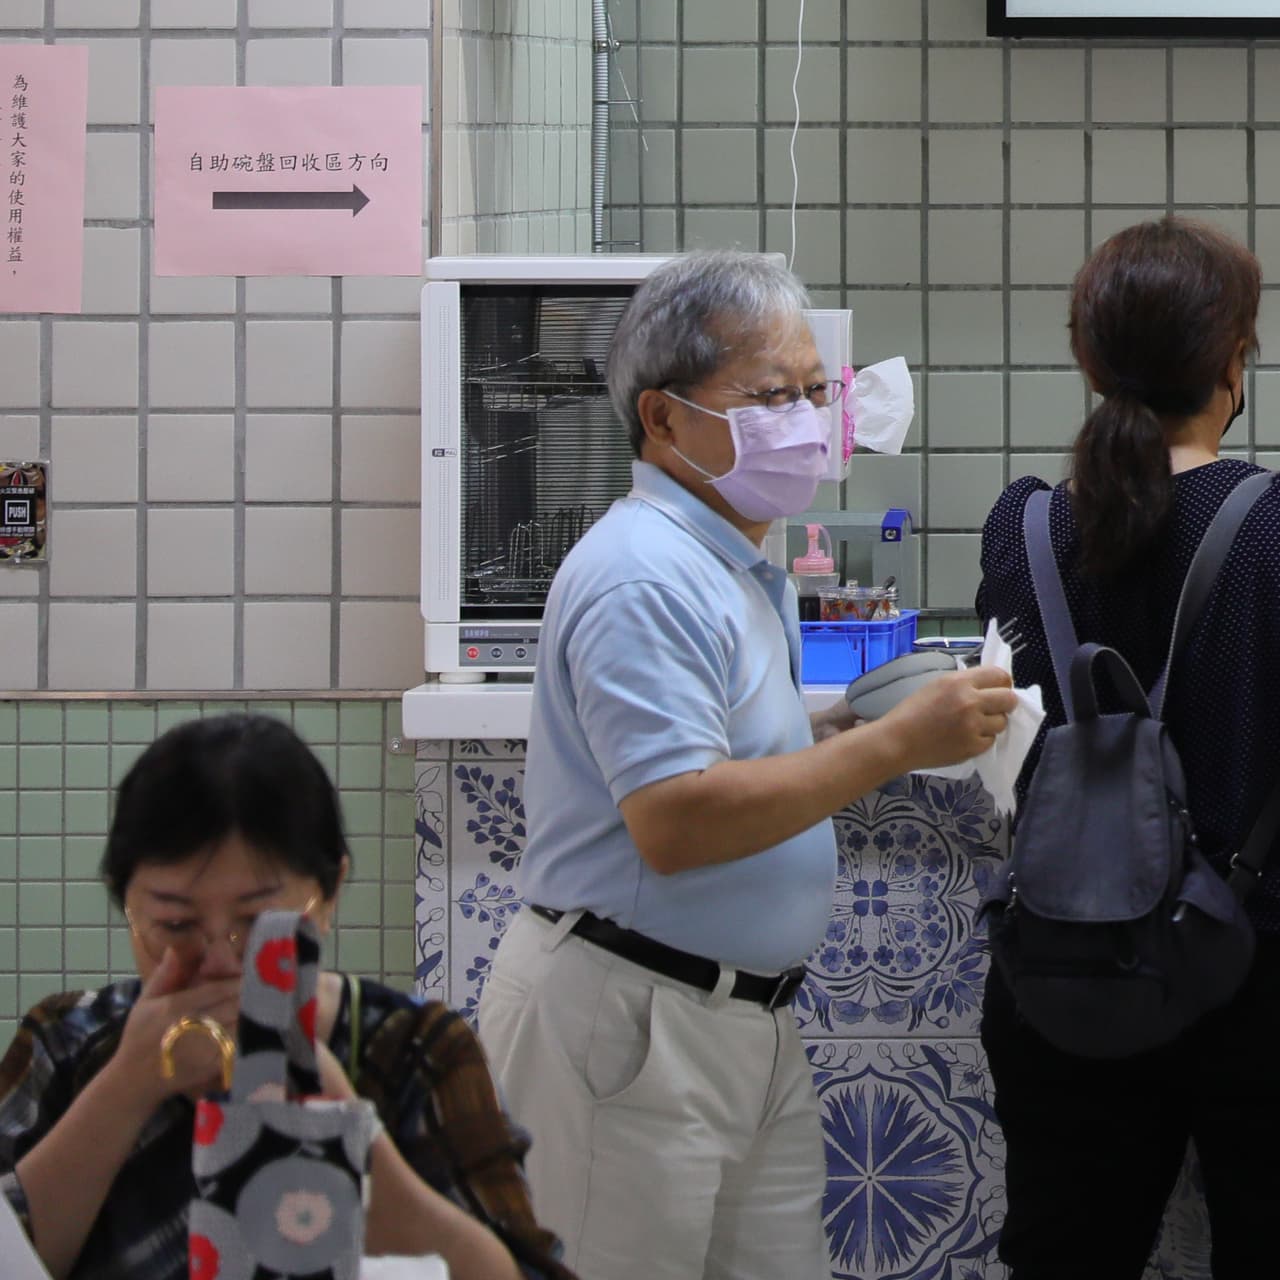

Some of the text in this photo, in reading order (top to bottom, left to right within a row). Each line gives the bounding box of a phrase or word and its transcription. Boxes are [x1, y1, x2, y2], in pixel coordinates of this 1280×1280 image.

[189, 151, 390, 174] 自助碗盤回收區方向
[8, 506, 27, 518] PUSH
